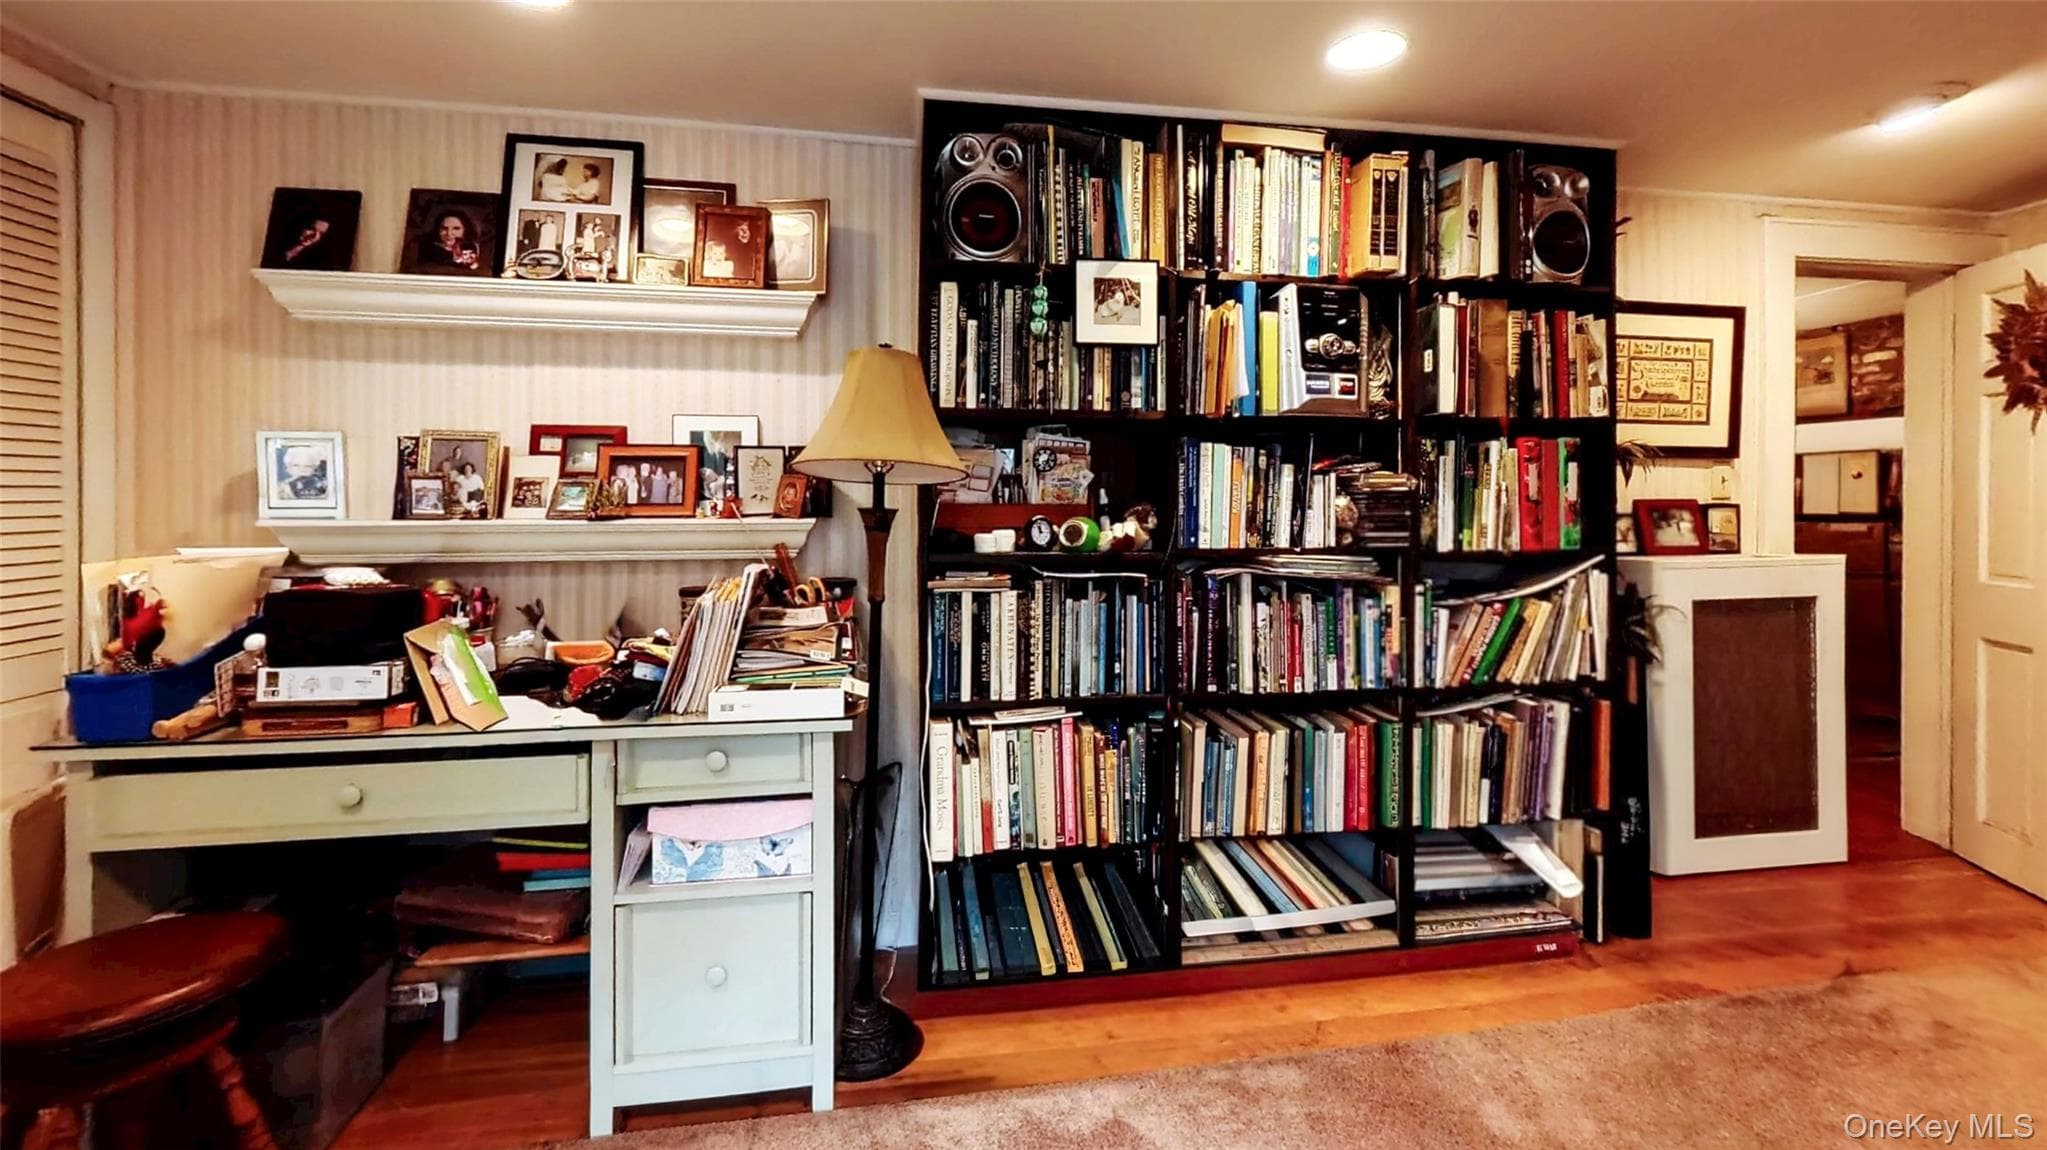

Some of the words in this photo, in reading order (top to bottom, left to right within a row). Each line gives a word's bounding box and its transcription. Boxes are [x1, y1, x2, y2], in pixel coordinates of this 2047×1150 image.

[1006, 601, 1014, 660] AKHENATEN
[935, 745, 948, 796] Grandma
[935, 798, 947, 832] Moses
